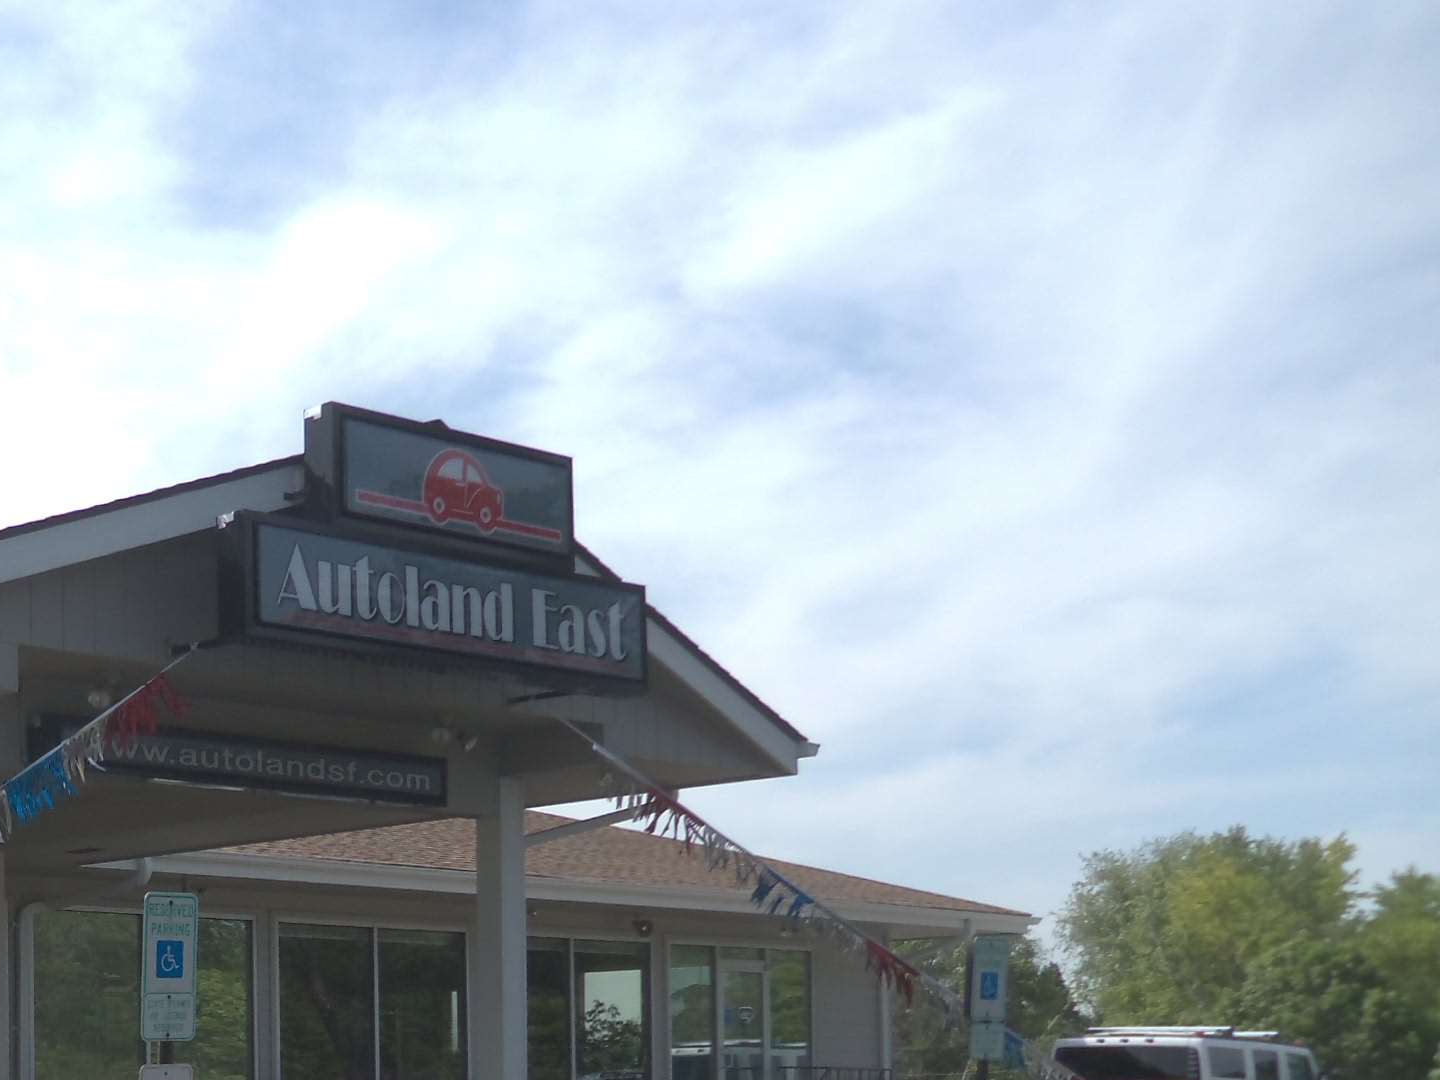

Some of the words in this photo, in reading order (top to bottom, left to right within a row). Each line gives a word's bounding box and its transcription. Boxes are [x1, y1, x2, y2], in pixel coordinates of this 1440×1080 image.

[277, 543, 515, 643] Autoland
[530, 587, 627, 662] East
[87, 738, 432, 793] ww.autolandsf.com
[151, 922, 191, 937] PARKING
